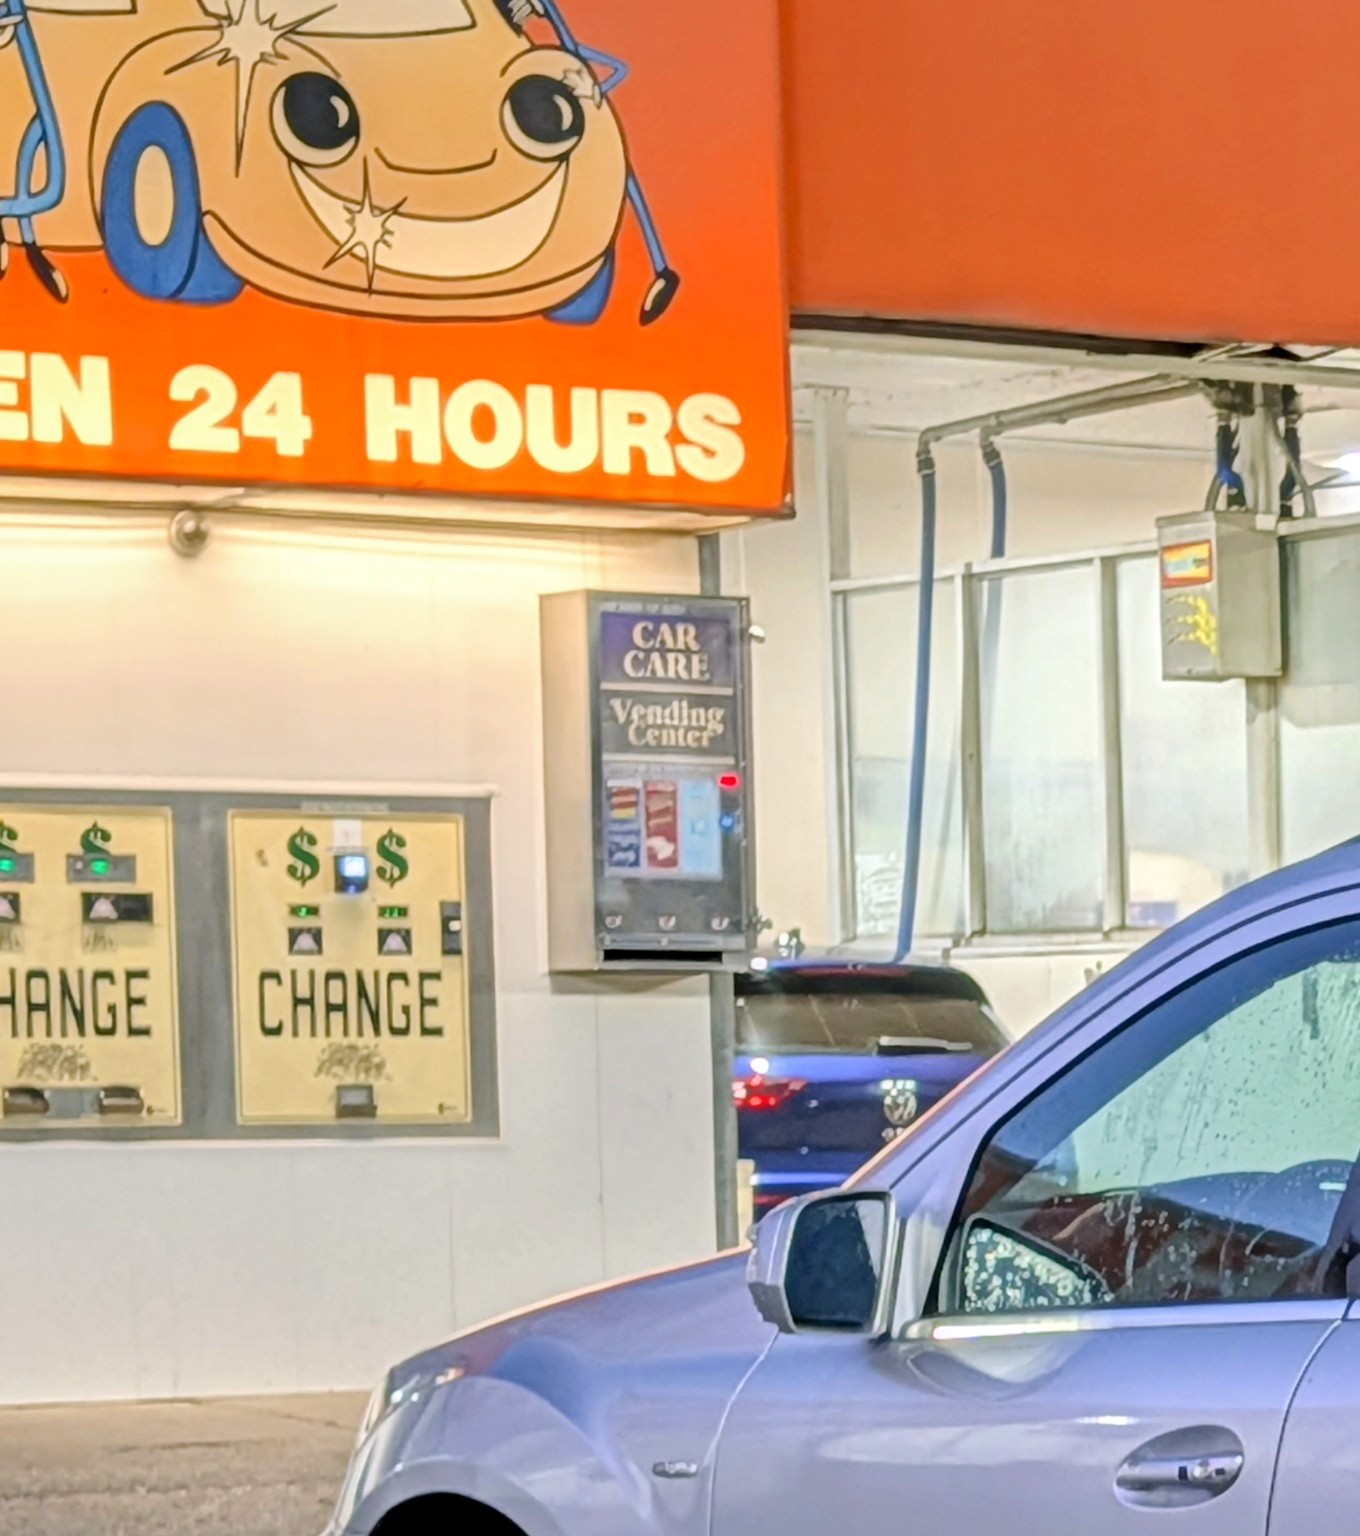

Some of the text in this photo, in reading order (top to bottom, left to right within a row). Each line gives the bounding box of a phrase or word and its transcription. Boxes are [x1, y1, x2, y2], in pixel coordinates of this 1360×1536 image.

[168, 363, 313, 458] 24
[364, 373, 746, 483] HOURS
[632, 621, 700, 652] CAR
[623, 649, 711, 681] CARE
[609, 698, 726, 737] Vending
[628, 721, 709, 749] Center
[258, 968, 445, 1038] CHANGE
